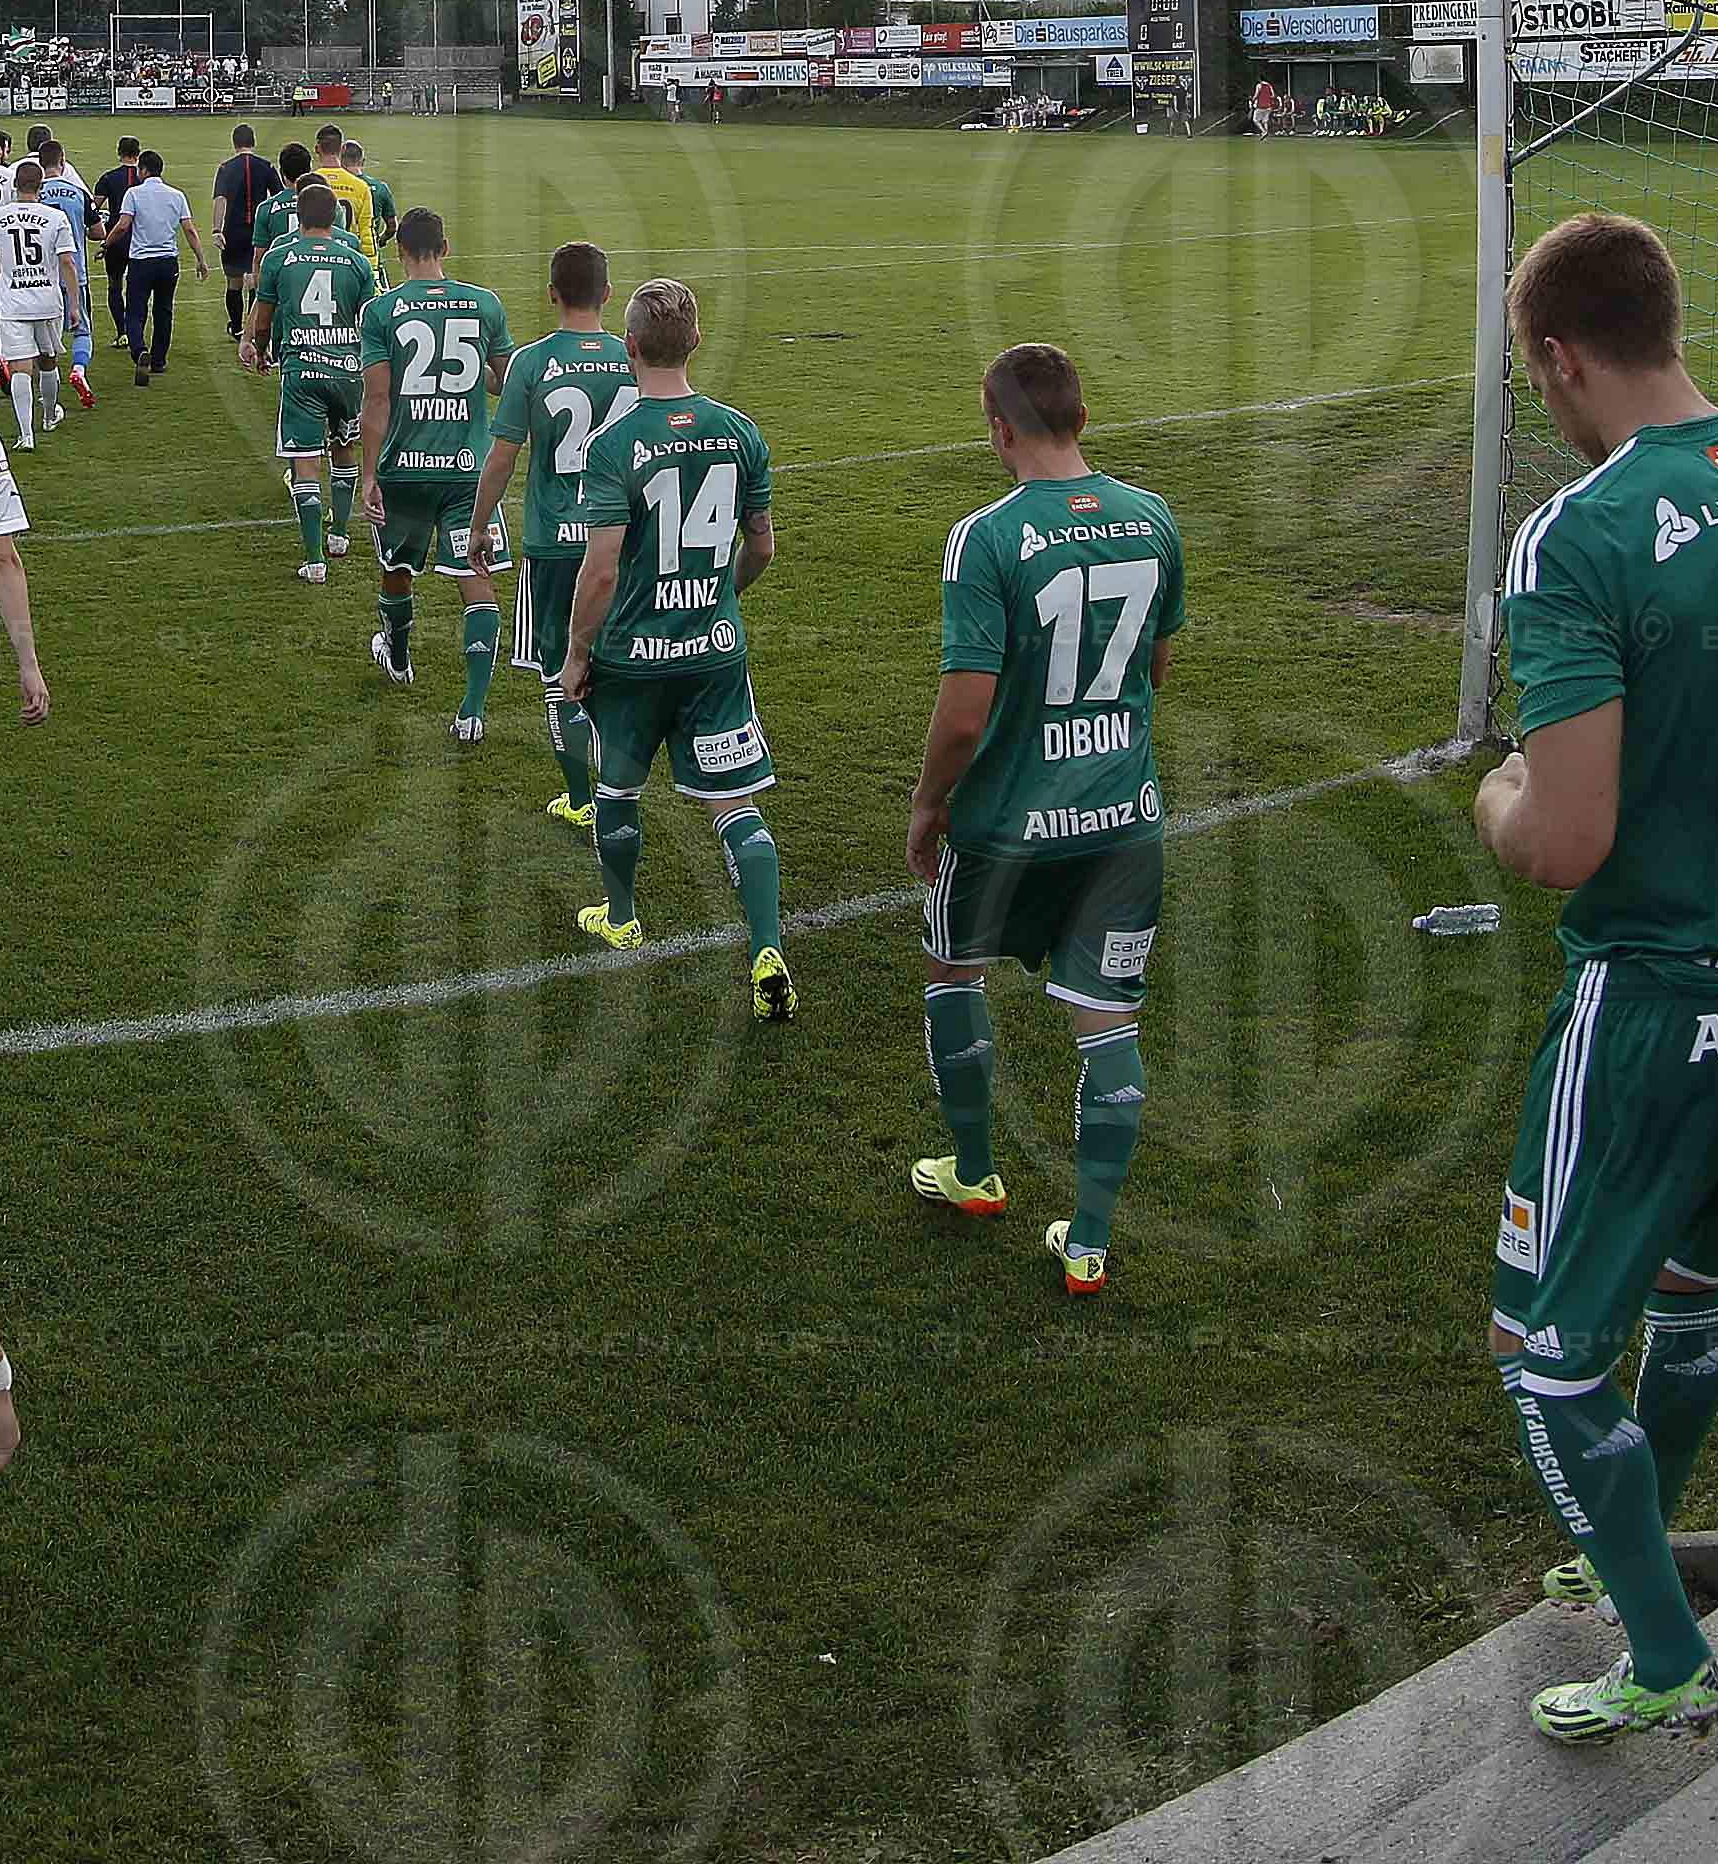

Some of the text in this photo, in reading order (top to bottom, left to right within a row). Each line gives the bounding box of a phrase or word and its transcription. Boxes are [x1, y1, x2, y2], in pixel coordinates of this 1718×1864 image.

[1242, 14, 1376, 39] Die Versicherung
[1523, 0, 1621, 32] STROBL
[1015, 23, 1128, 46] Die Bausparkas
[1140, 22, 1183, 41] 0 0
[759, 65, 807, 81] SIEMENS
[937, 63, 982, 73] VOLKSBANK
[48, 189, 77, 200] WEIZ
[0, 214, 50, 228] SC WEIZ
[7, 229, 43, 266] 15
[300, 269, 337, 326] 4
[409, 300, 478, 312] LYONESS
[395, 319, 482, 396] 25
[564, 360, 630, 375] LYONES
[409, 398, 470, 422] WYDRA
[397, 449, 455, 469] Allianz
[652, 438, 739, 456] LYONESS
[642, 463, 739, 576] 14
[556, 521, 588, 543] Alli
[1047, 520, 1154, 547] LYONESS
[655, 576, 721, 611] KAINZ
[1034, 559, 1161, 706] 17
[628, 635, 710, 661] Allianz
[697, 736, 731, 753] card
[1042, 712, 1132, 763] DIBON
[1022, 799, 1137, 842] Allianz
